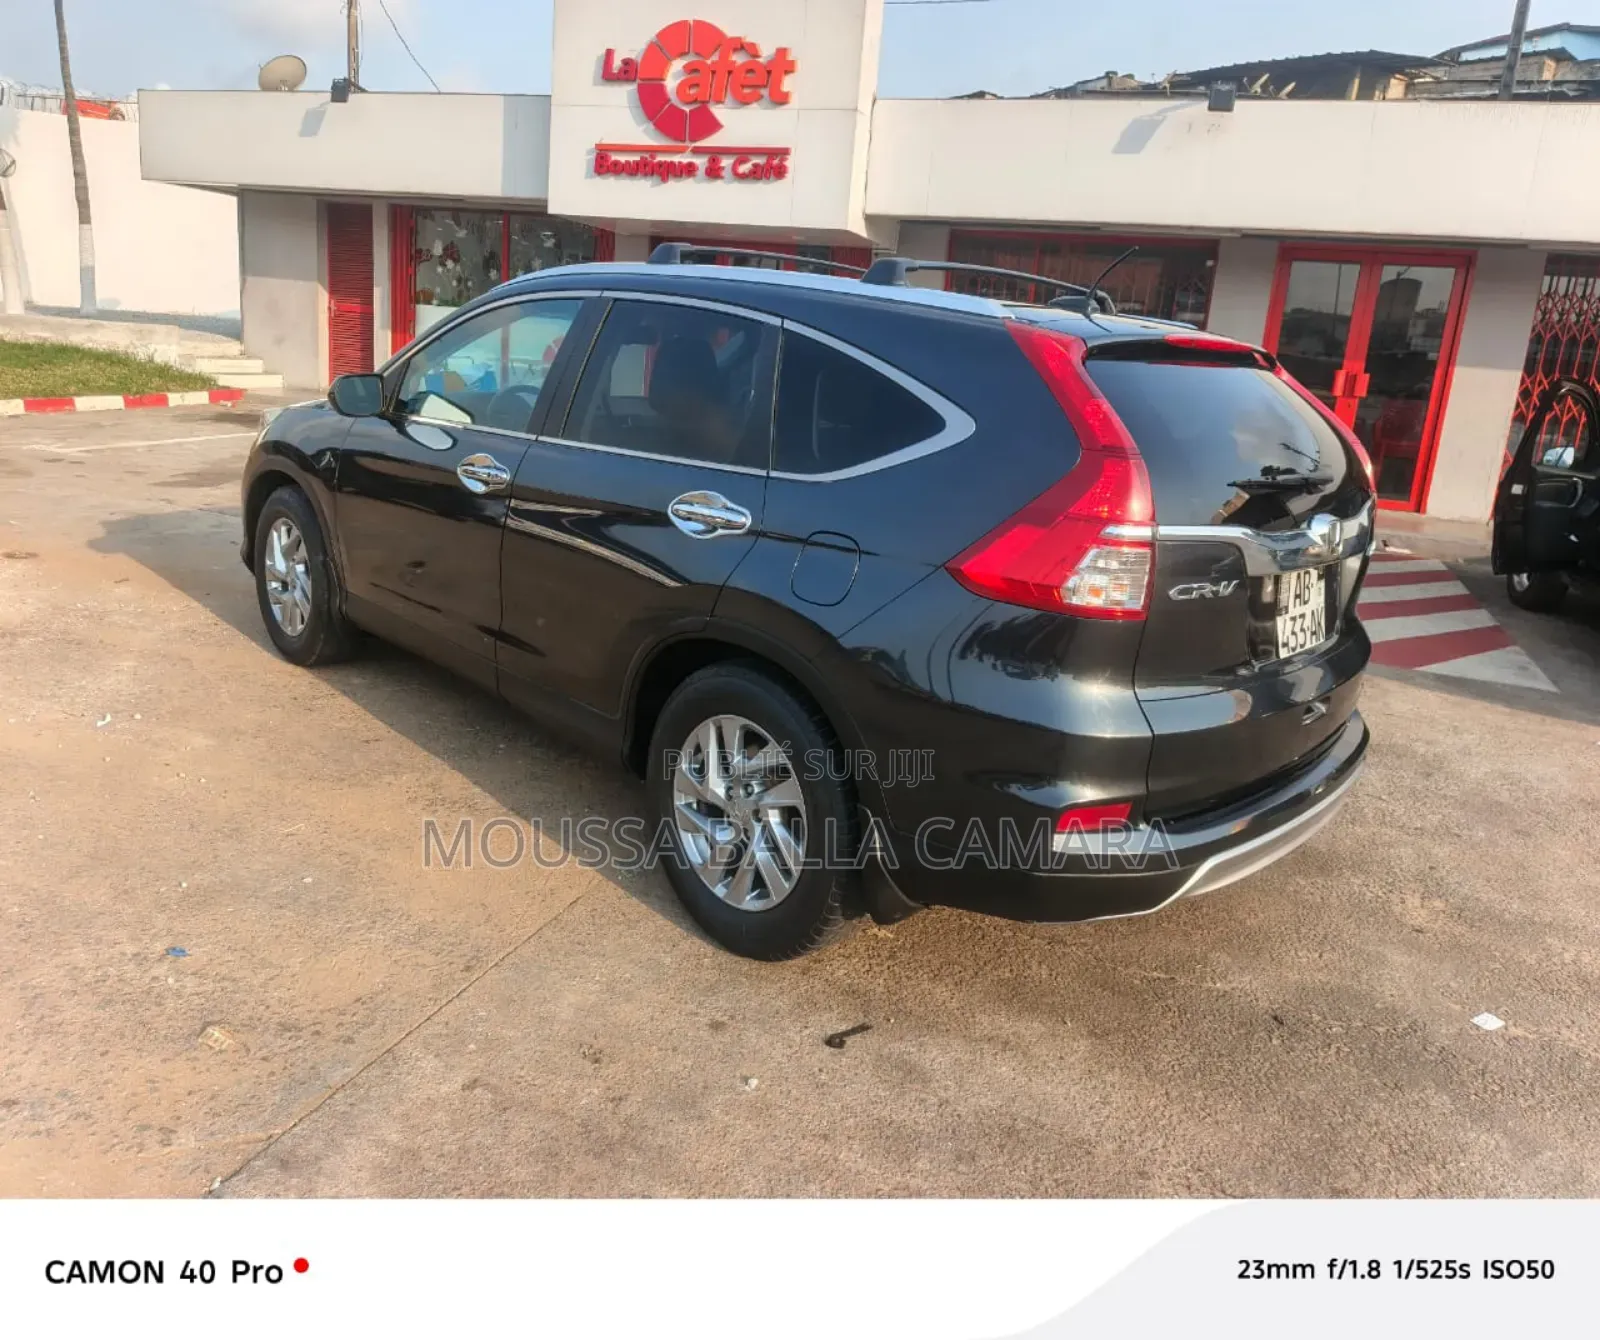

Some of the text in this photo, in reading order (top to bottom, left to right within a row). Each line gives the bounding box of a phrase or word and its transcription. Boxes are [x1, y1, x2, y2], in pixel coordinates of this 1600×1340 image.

[602, 48, 638, 82] La
[594, 151, 789, 183] Boutique & Café
